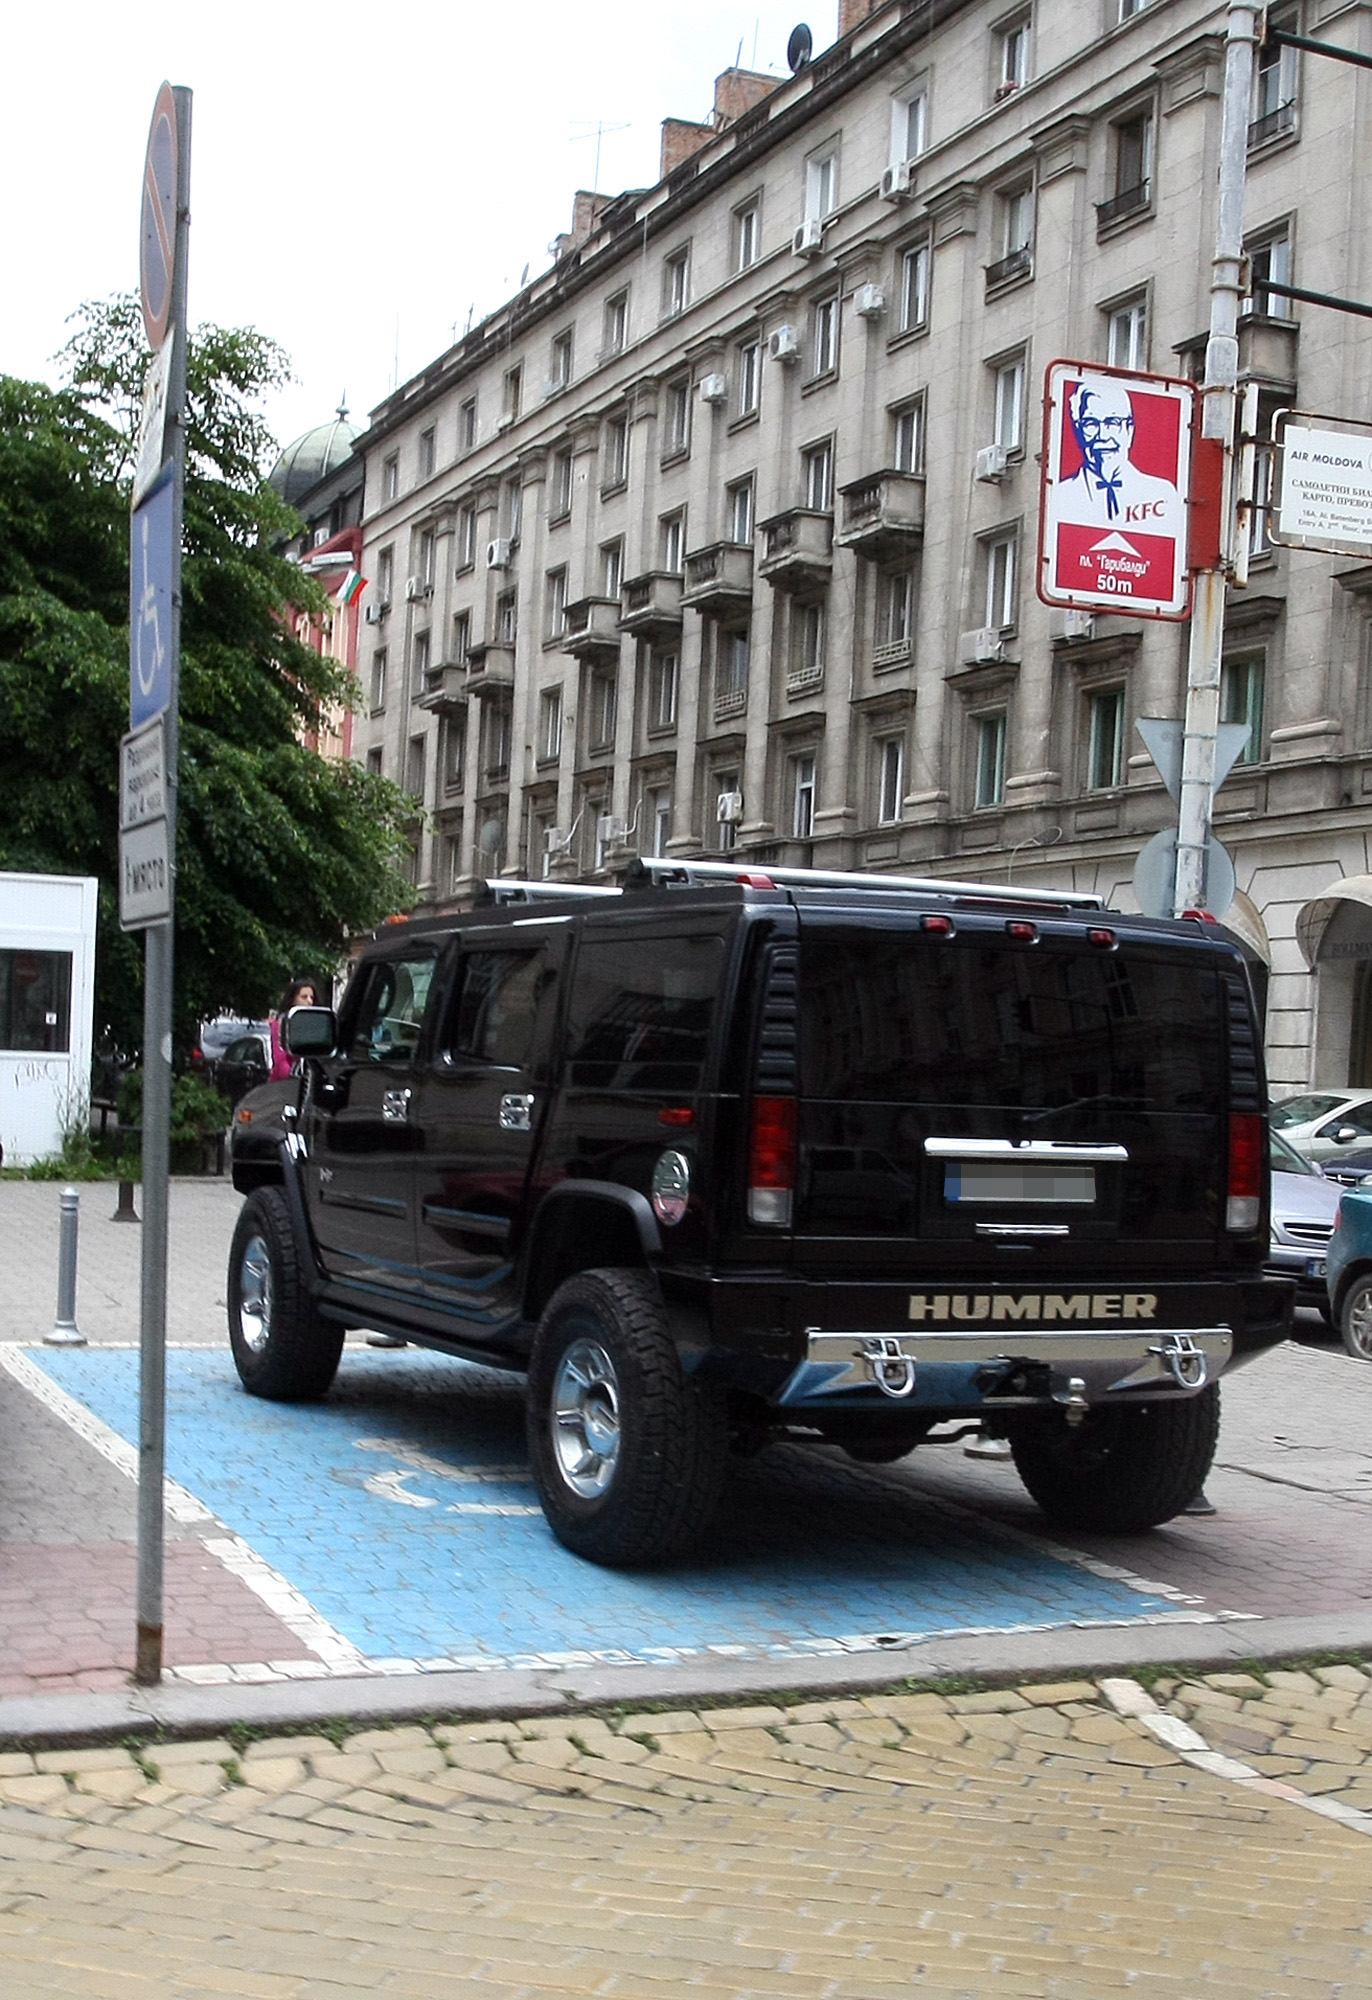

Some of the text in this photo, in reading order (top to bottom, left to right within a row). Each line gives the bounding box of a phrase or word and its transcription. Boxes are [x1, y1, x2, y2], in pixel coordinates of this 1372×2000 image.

[1291, 451, 1363, 469] AIR MOLDOVA
[1291, 479, 1350, 494] САМОЛЕТНИ
[1302, 491, 1335, 504] КАРГО,
[1125, 500, 1165, 523] KFC
[908, 1294, 1158, 1320] HUMMER
